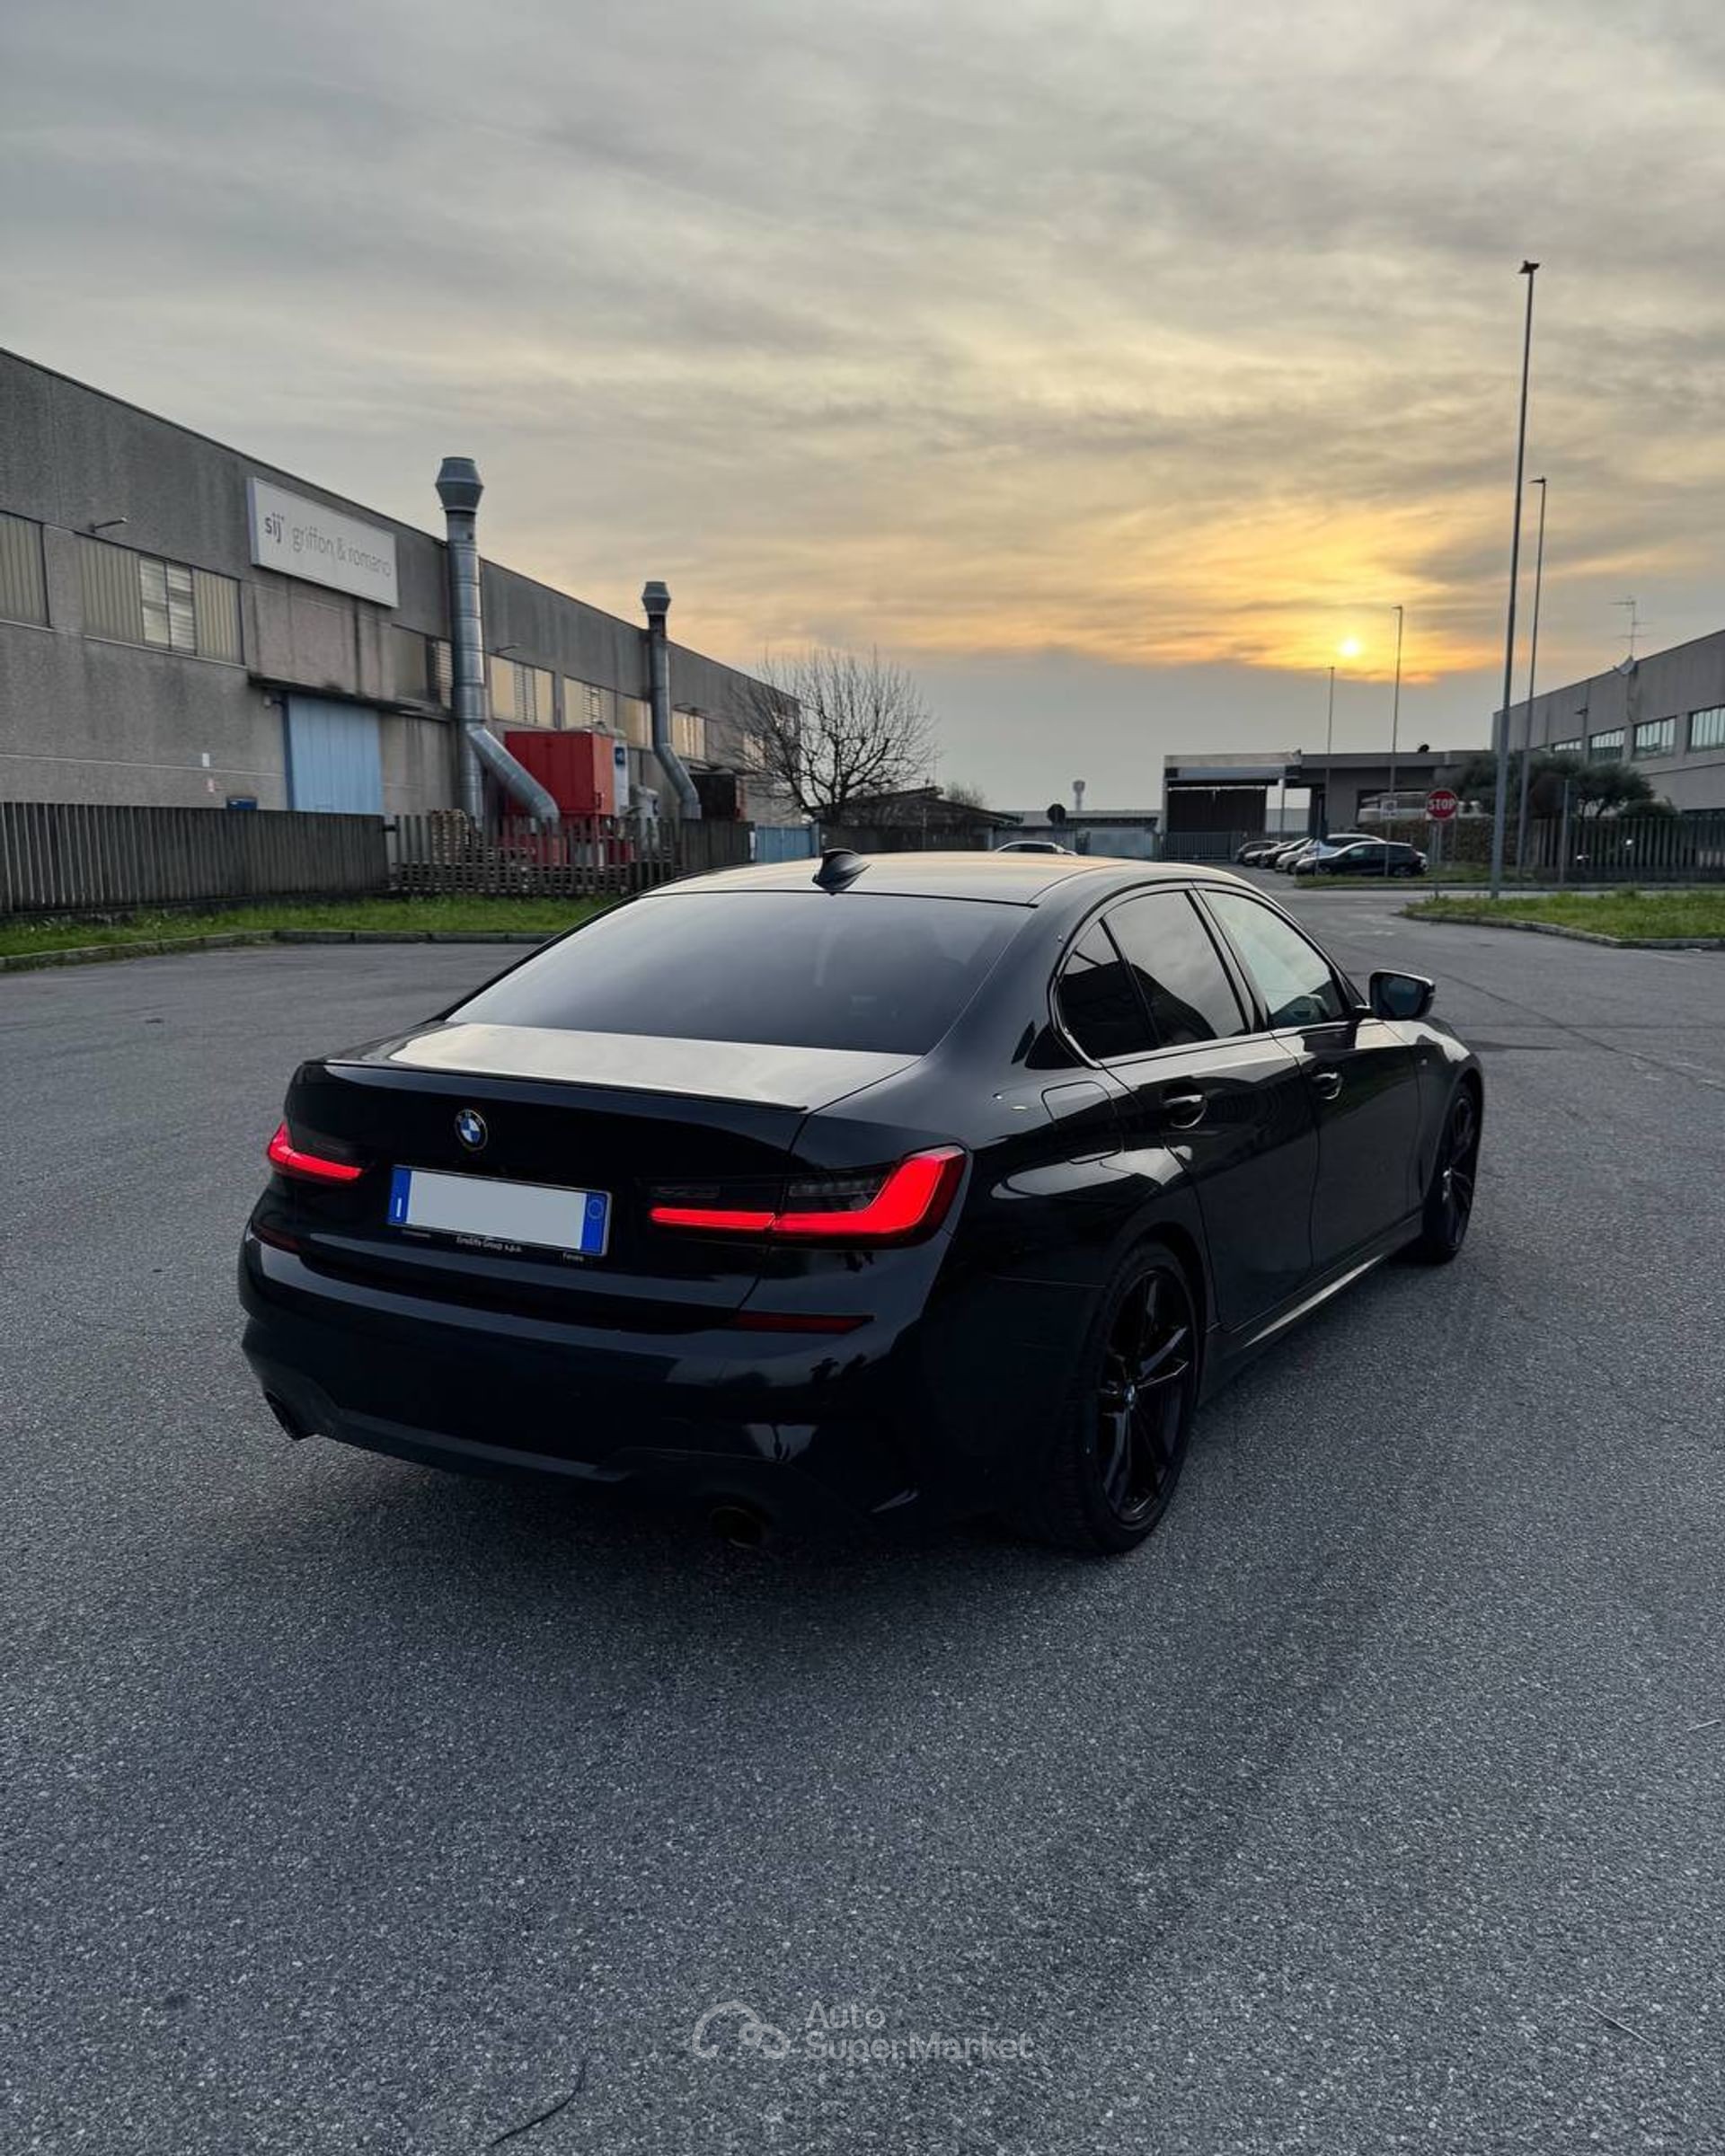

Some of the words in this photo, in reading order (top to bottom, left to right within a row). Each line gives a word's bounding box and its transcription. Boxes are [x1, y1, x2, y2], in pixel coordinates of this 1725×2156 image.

[293, 526, 333, 555] griffon
[337, 537, 347, 561] &
[349, 547, 392, 577] romano
[1429, 799, 1455, 810] STOP
